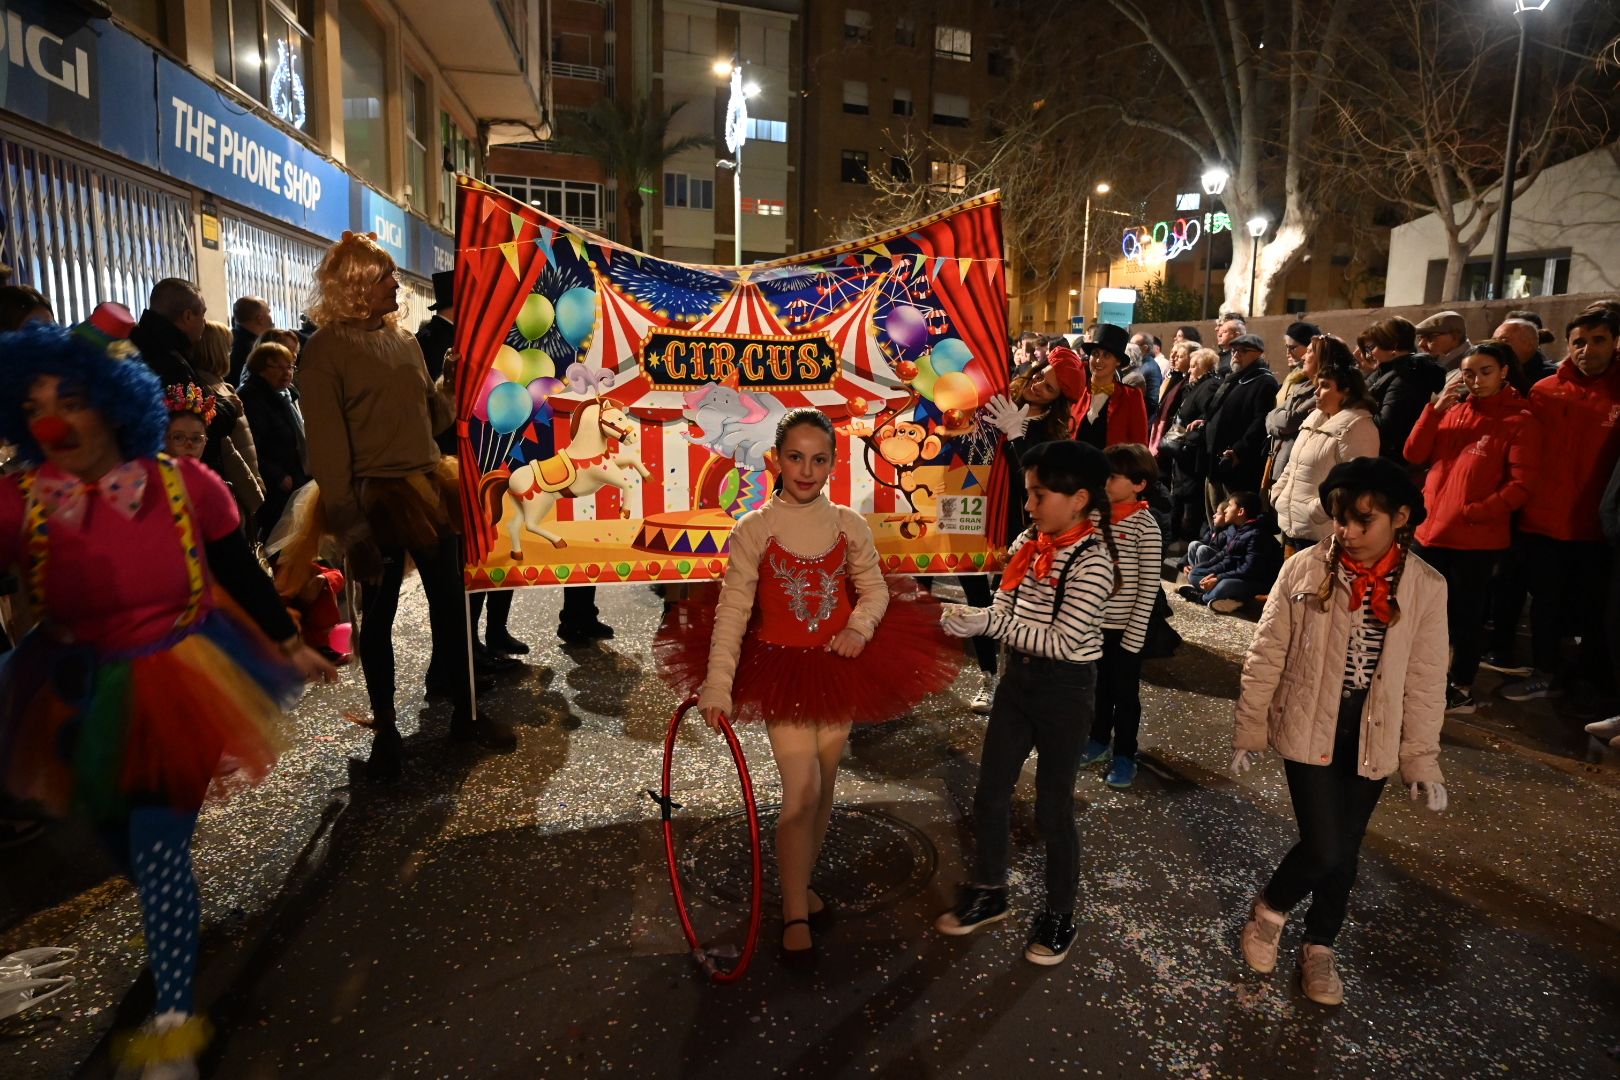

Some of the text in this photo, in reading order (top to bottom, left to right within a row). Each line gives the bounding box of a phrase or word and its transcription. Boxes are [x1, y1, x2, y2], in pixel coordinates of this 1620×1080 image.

[172, 96, 321, 212] THE PHONE SHOP
[376, 215, 402, 249] DIGI
[662, 340, 820, 380] CIRCUS
[961, 497, 982, 515] 12
